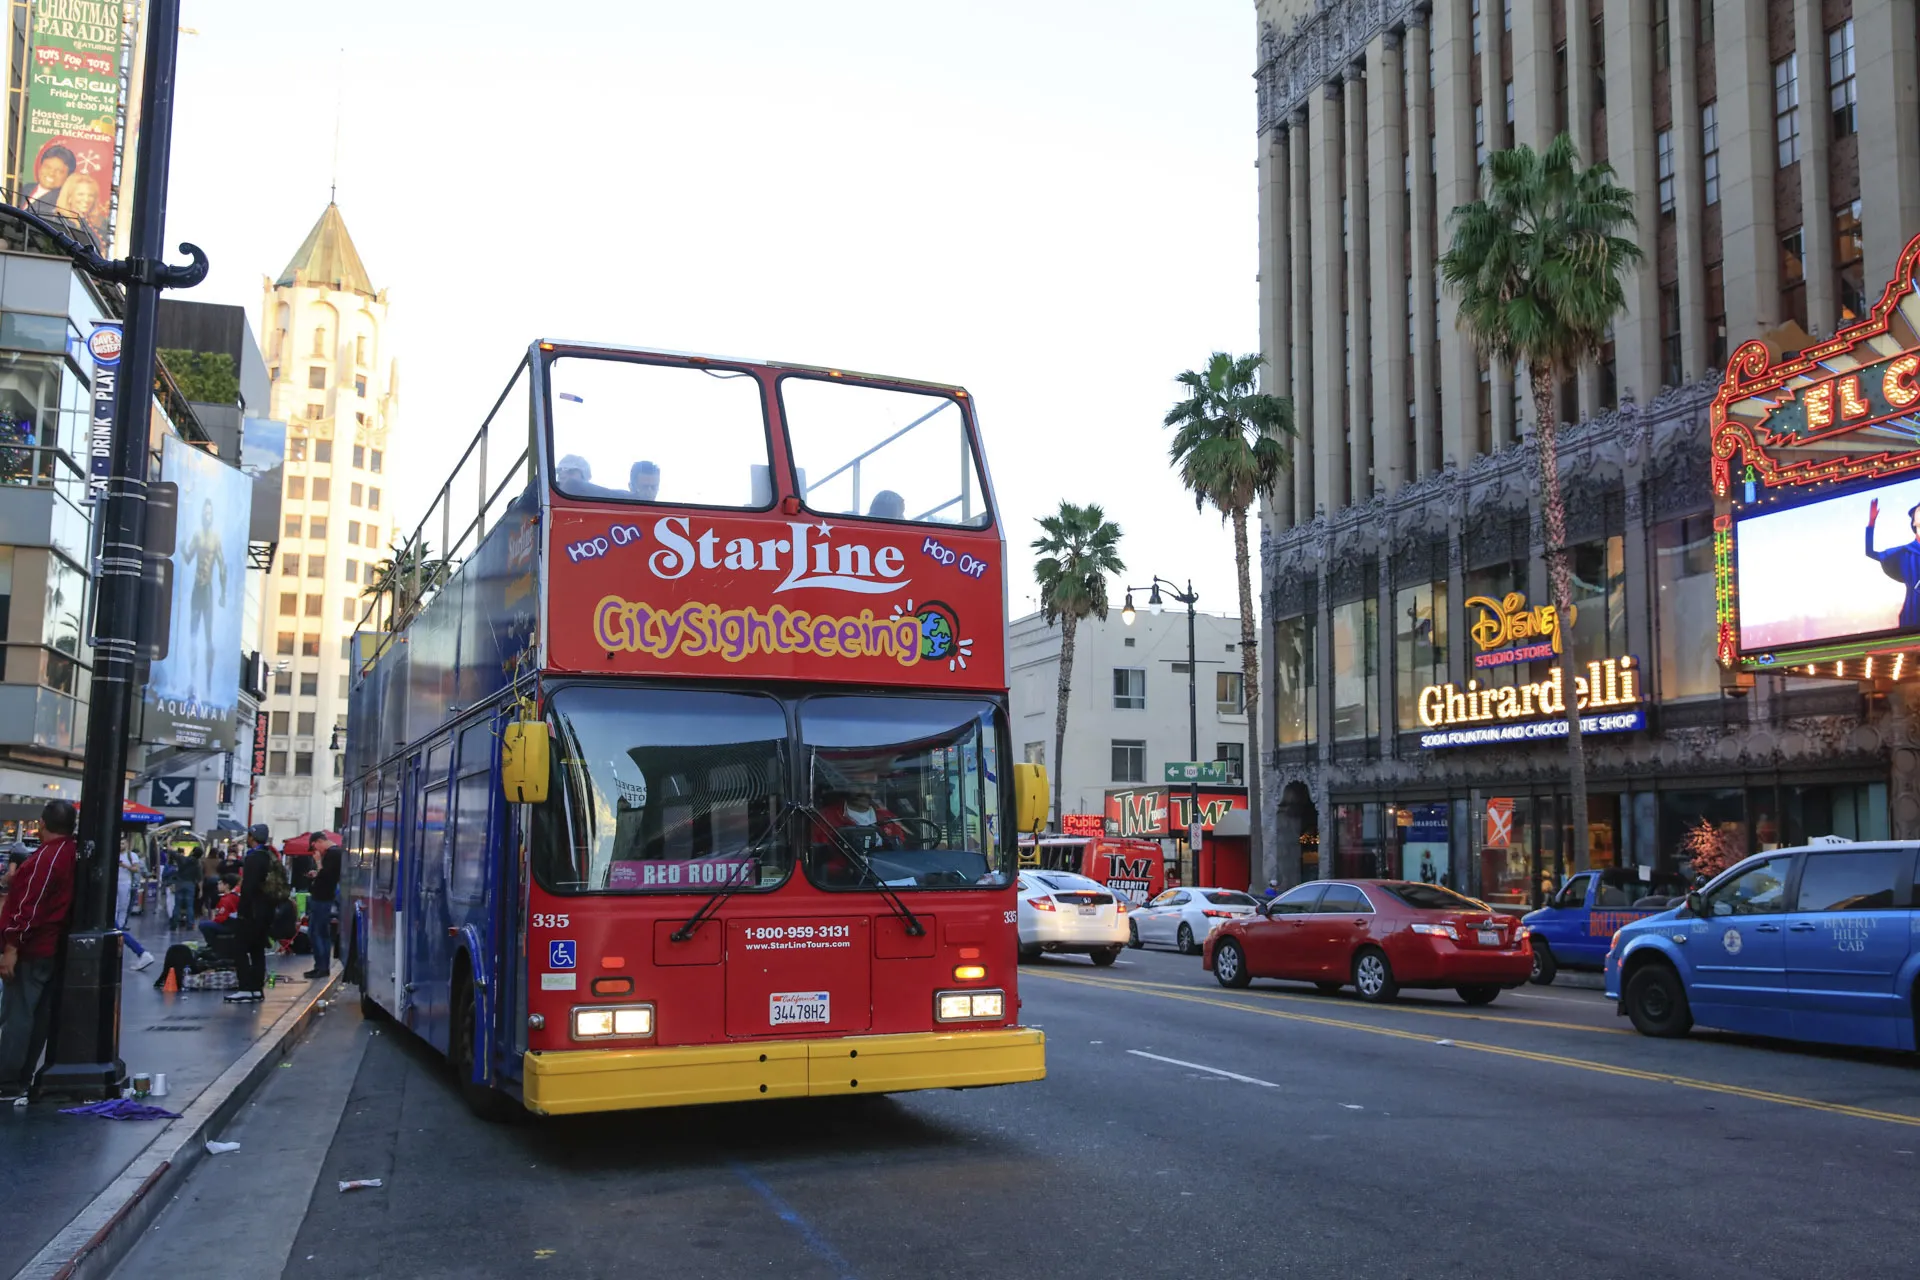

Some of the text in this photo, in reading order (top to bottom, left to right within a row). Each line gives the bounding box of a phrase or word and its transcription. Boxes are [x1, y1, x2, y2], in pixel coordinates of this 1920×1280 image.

[38, 0, 118, 28] CHRISTMAS
[37, 18, 117, 44] PARADE
[37, 49, 110, 71] TOYS FOR TOTS
[50, 88, 114, 104] Friday Dec. 14
[32, 108, 84, 124] Hosted by
[77, 102, 97, 110] 8:00
[98, 105, 114, 113] PM
[31, 117, 51, 126] Erik
[53, 120, 93, 132] Estrada
[31, 124, 111, 142] Laura McKenzie
[95, 368, 115, 401] PLAY
[1804, 374, 1868, 432] EL
[92, 417, 112, 457] DRINK
[568, 524, 642, 563] Hop On
[922, 537, 988, 578] Hop Off
[1475, 643, 1553, 668] STUDIO STORE
[1418, 655, 1637, 727] Ghirardelli
[157, 698, 227, 722] AQUAMAN
[1421, 733, 1448, 747] SODA
[1448, 727, 1500, 744] FOUNTAIN
[1500, 725, 1524, 739] AND
[1598, 714, 1637, 730] SHOP
[1202, 767, 1221, 777] Fwy
[1067, 816, 1101, 827] Public
[1114, 791, 1161, 837] TMZ
[1065, 827, 1104, 837] Parking
[643, 863, 681, 885] RED
[688, 863, 749, 884] ROUTE
[1103, 854, 1154, 878] TMZ
[1107, 879, 1149, 890] CELEBRITY
[532, 913, 570, 928] 335
[1003, 910, 1017, 924] 335
[1823, 917, 1877, 929] BEVERLY
[744, 925, 849, 939] 1-800-959-3131
[1833, 929, 1868, 940] HILLS
[746, 941, 850, 950] www.StarLineTours.com
[1838, 941, 1864, 951] CAB
[774, 1004, 826, 1021] 34478H2
